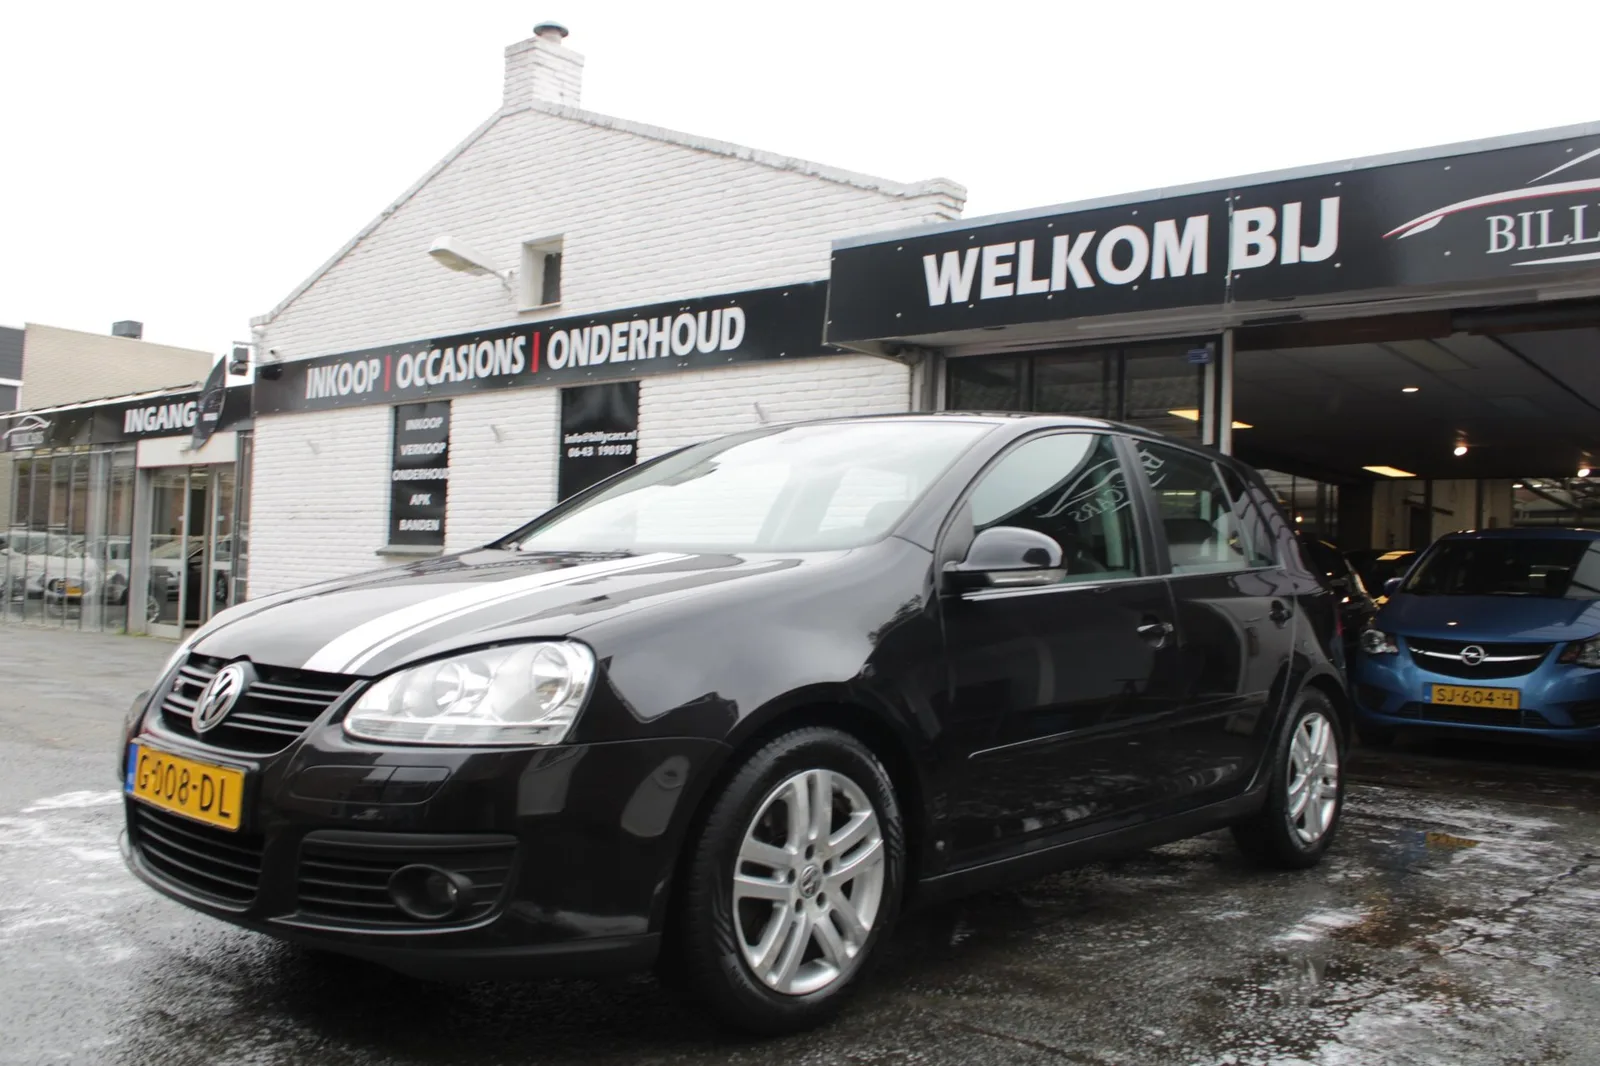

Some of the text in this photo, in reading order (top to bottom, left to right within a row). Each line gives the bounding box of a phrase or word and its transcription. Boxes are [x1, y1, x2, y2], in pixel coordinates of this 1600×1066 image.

[1485, 203, 1600, 254] BILL
[922, 195, 1341, 307] WELKOM BIJ
[546, 307, 746, 370] ONDERHOUD
[306, 358, 380, 400] INKOOP
[395, 336, 526, 389] OCCASIONS
[123, 401, 198, 434] INGANG
[405, 416, 444, 431] INKOOP
[400, 442, 447, 456] VERKOOP
[409, 493, 432, 506] APK
[399, 519, 440, 531] BANDEN
[1436, 687, 1514, 707] SJ-604-H
